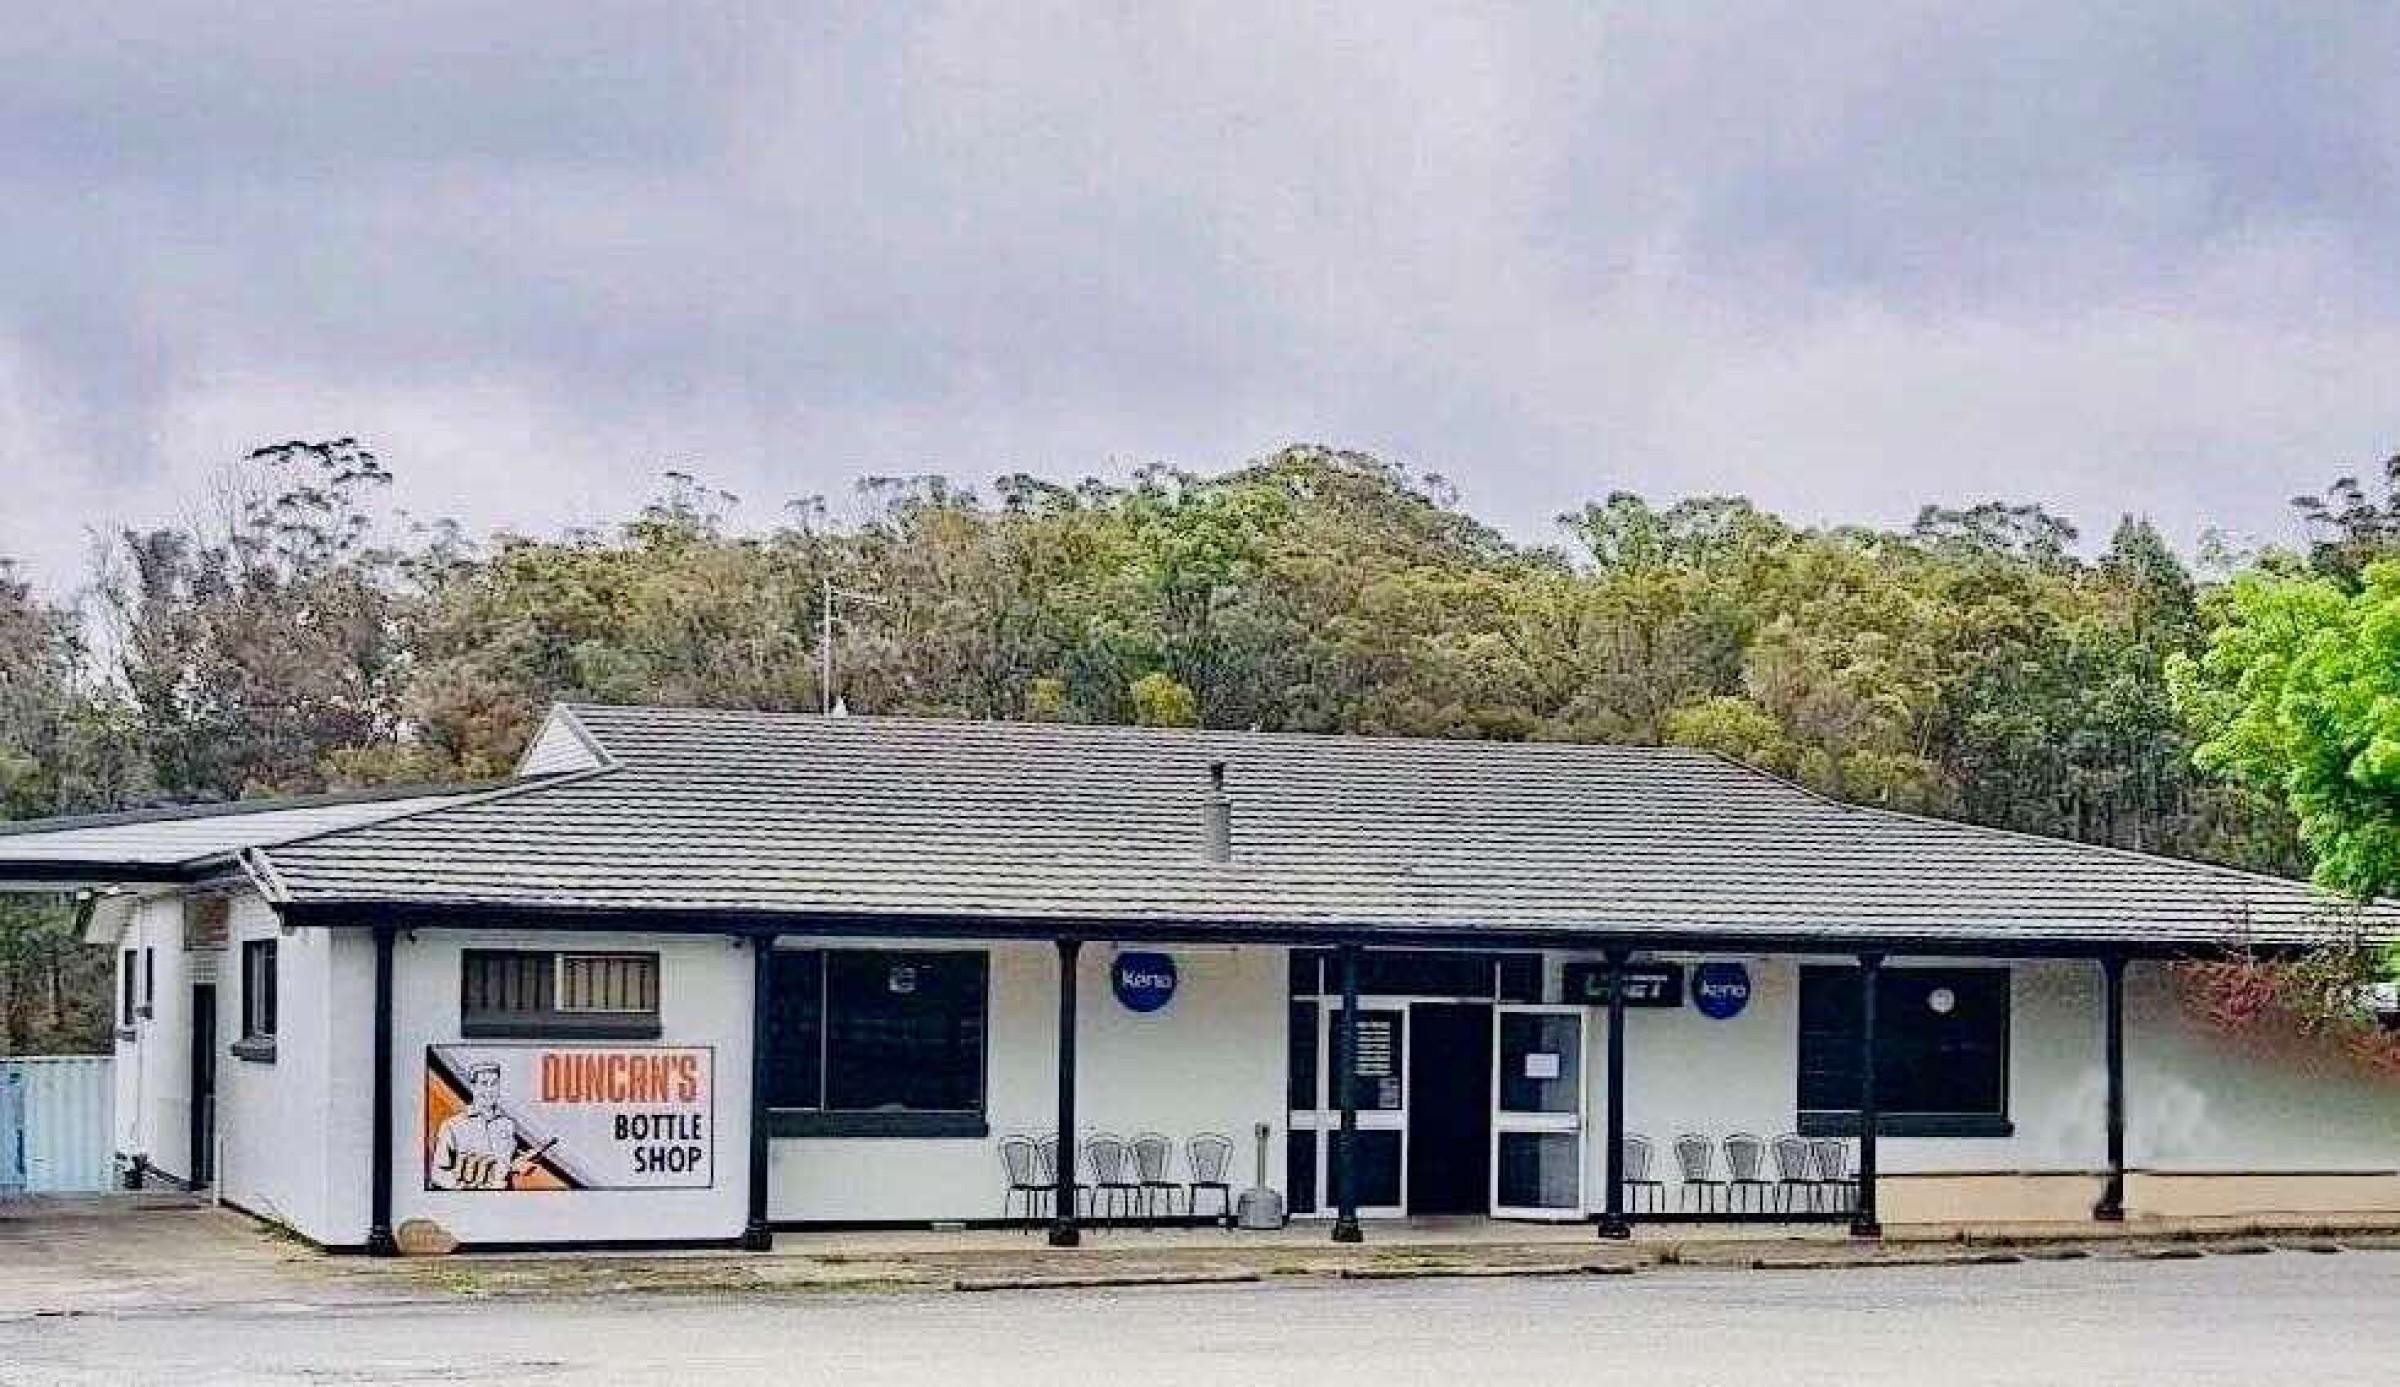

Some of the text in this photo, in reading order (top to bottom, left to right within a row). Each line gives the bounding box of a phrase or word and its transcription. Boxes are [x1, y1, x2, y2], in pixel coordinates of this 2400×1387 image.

[542, 1053, 698, 1103] DUNCAN'S
[614, 1114, 702, 1140] BOTTLE
[634, 1146, 702, 1173] SHOP
